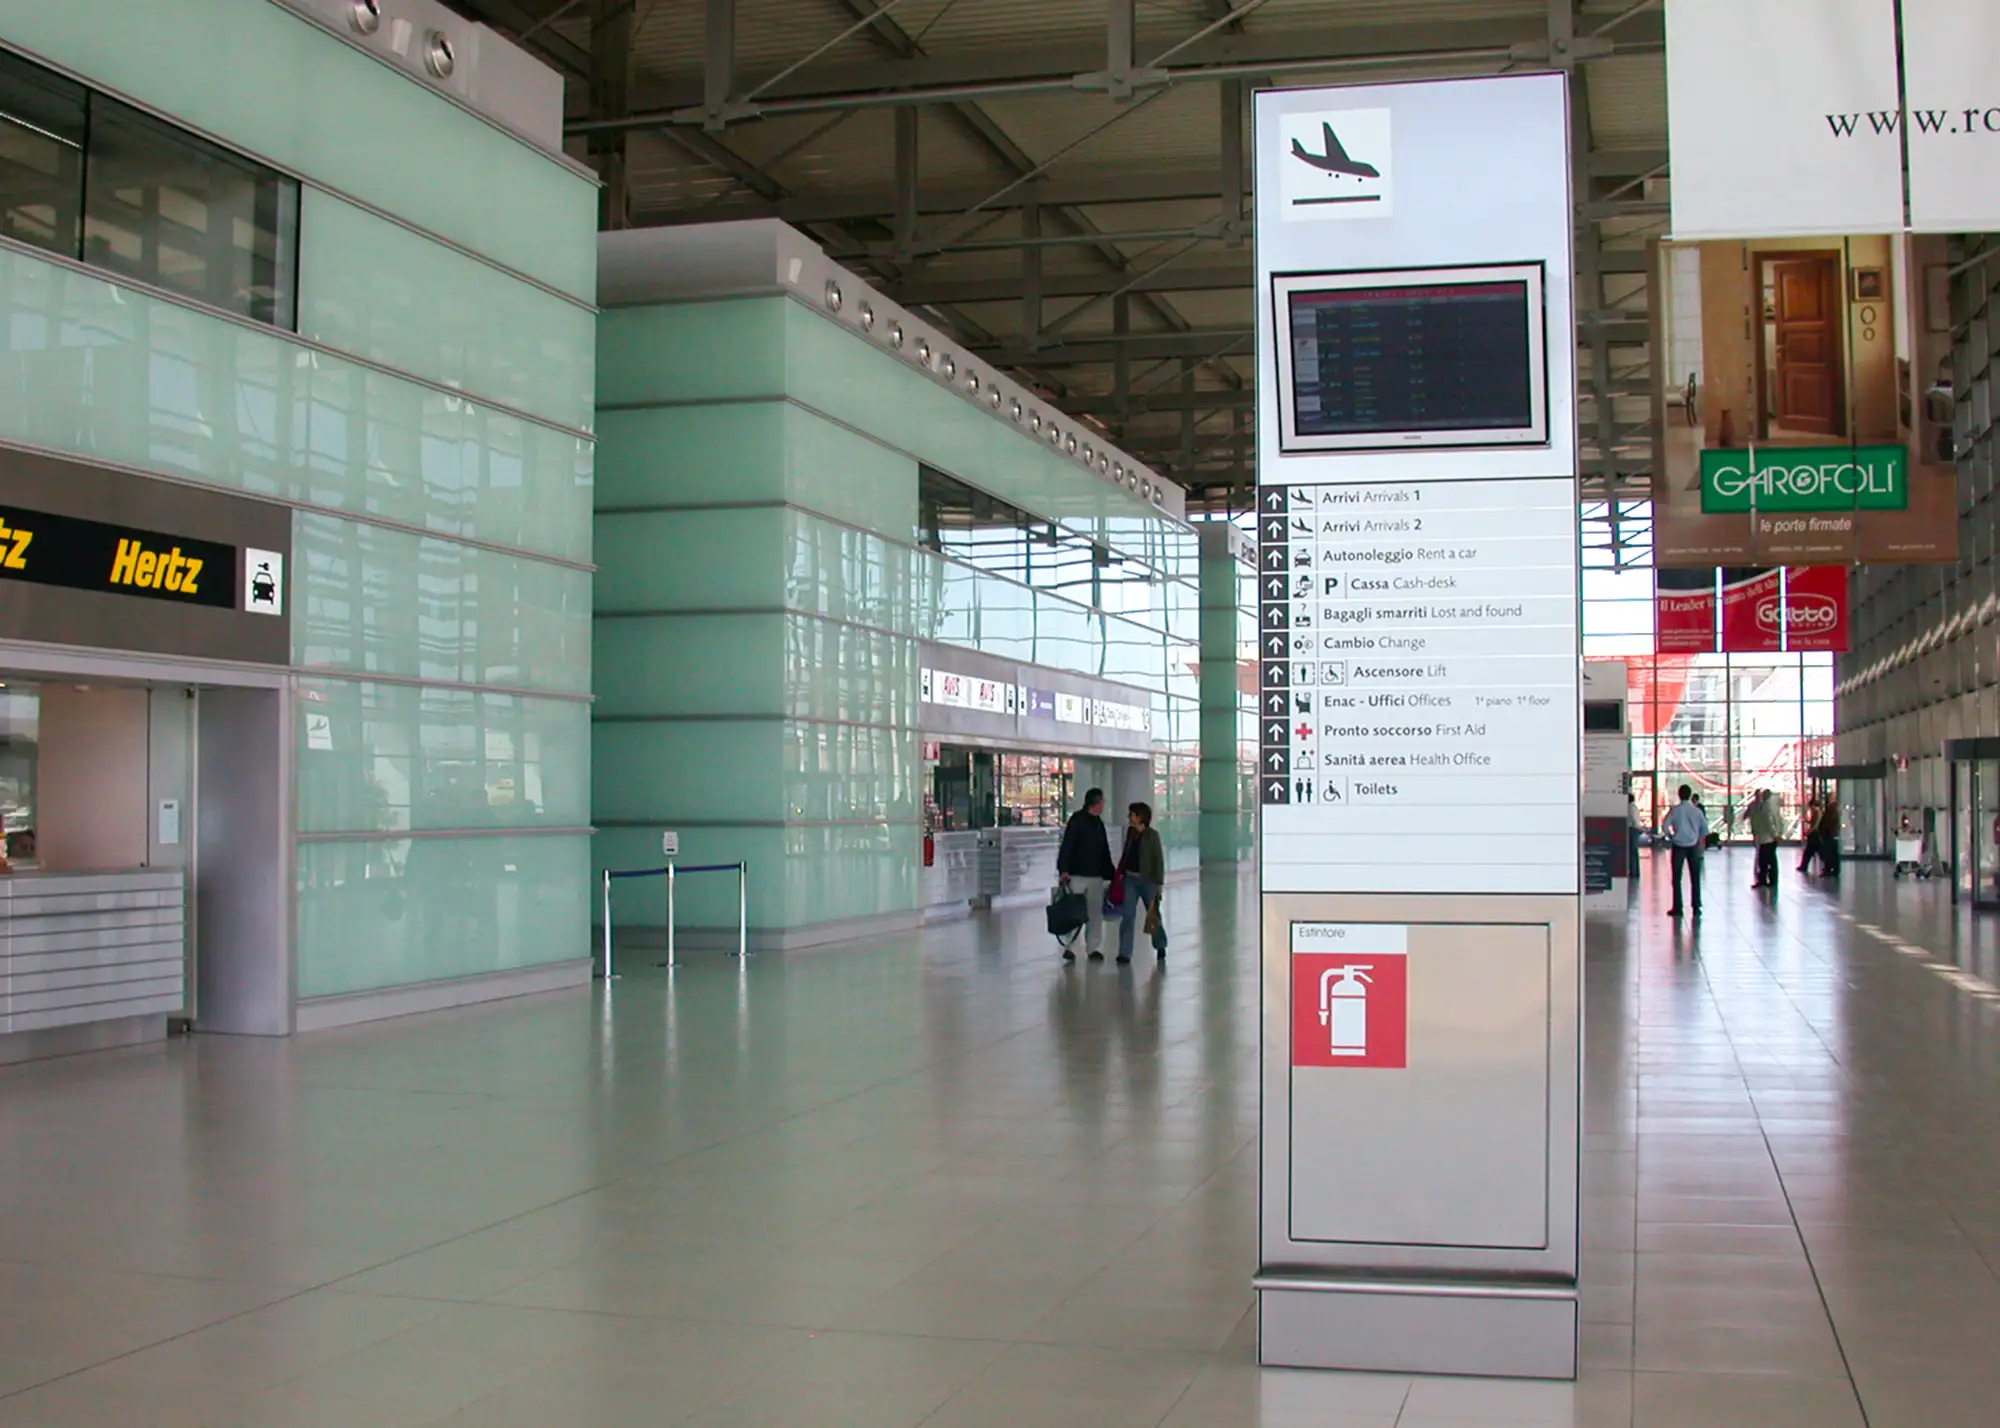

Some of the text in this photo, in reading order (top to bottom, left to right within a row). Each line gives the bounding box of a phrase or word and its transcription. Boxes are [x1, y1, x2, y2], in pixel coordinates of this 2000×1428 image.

[1323, 489, 1421, 503] Arrivi Arrivals 1
[1323, 518, 1422, 532] Arrivi Arrivals 2
[1760, 517, 1852, 534] le porte firmate
[1323, 548, 1476, 563] Autonoleggio Rent a car
[110, 538, 203, 593] Hertz
[1351, 578, 1389, 590] Cassa
[1393, 576, 1456, 589] Cash-desk
[1324, 605, 1522, 623] Bagagli smarriti Lost and found
[1324, 636, 1425, 651] Cambio Change
[1354, 664, 1446, 677] Ascensore Lift
[1325, 696, 1355, 707] Enac
[1369, 695, 1404, 706] Uffici
[1408, 694, 1451, 706] Offices
[1486, 699, 1512, 707] piano
[1529, 695, 1550, 705] floor
[1325, 724, 1485, 736] Pronto soccorso First Aid
[1370, 757, 1405, 765] aerea
[1410, 754, 1450, 765] Health
[1453, 752, 1490, 765] Office
[1355, 783, 1397, 795] Toilets
[1299, 926, 1345, 938] Estintore
